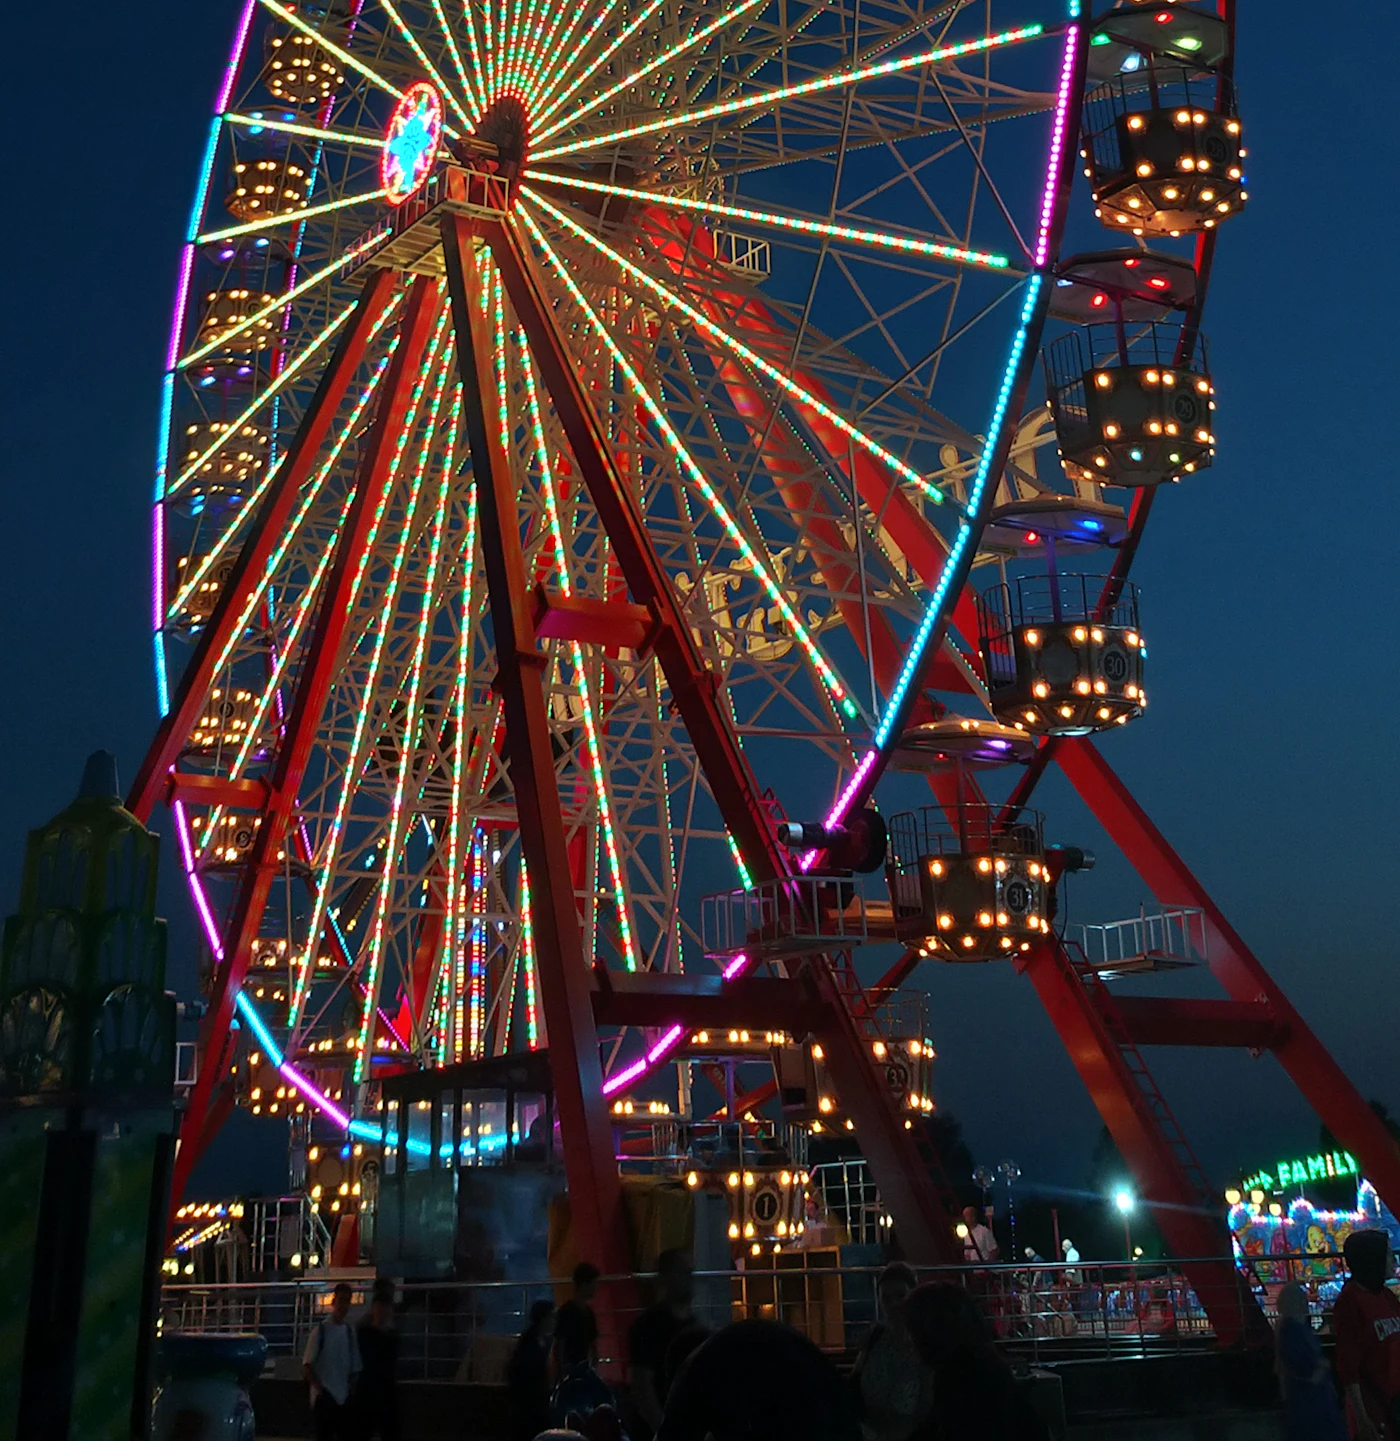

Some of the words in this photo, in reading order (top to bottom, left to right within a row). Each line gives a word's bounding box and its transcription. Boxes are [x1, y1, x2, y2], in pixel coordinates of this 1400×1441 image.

[1178, 399, 1193, 418] 29
[1107, 656, 1122, 675] 30
[1011, 886, 1025, 906] 31
